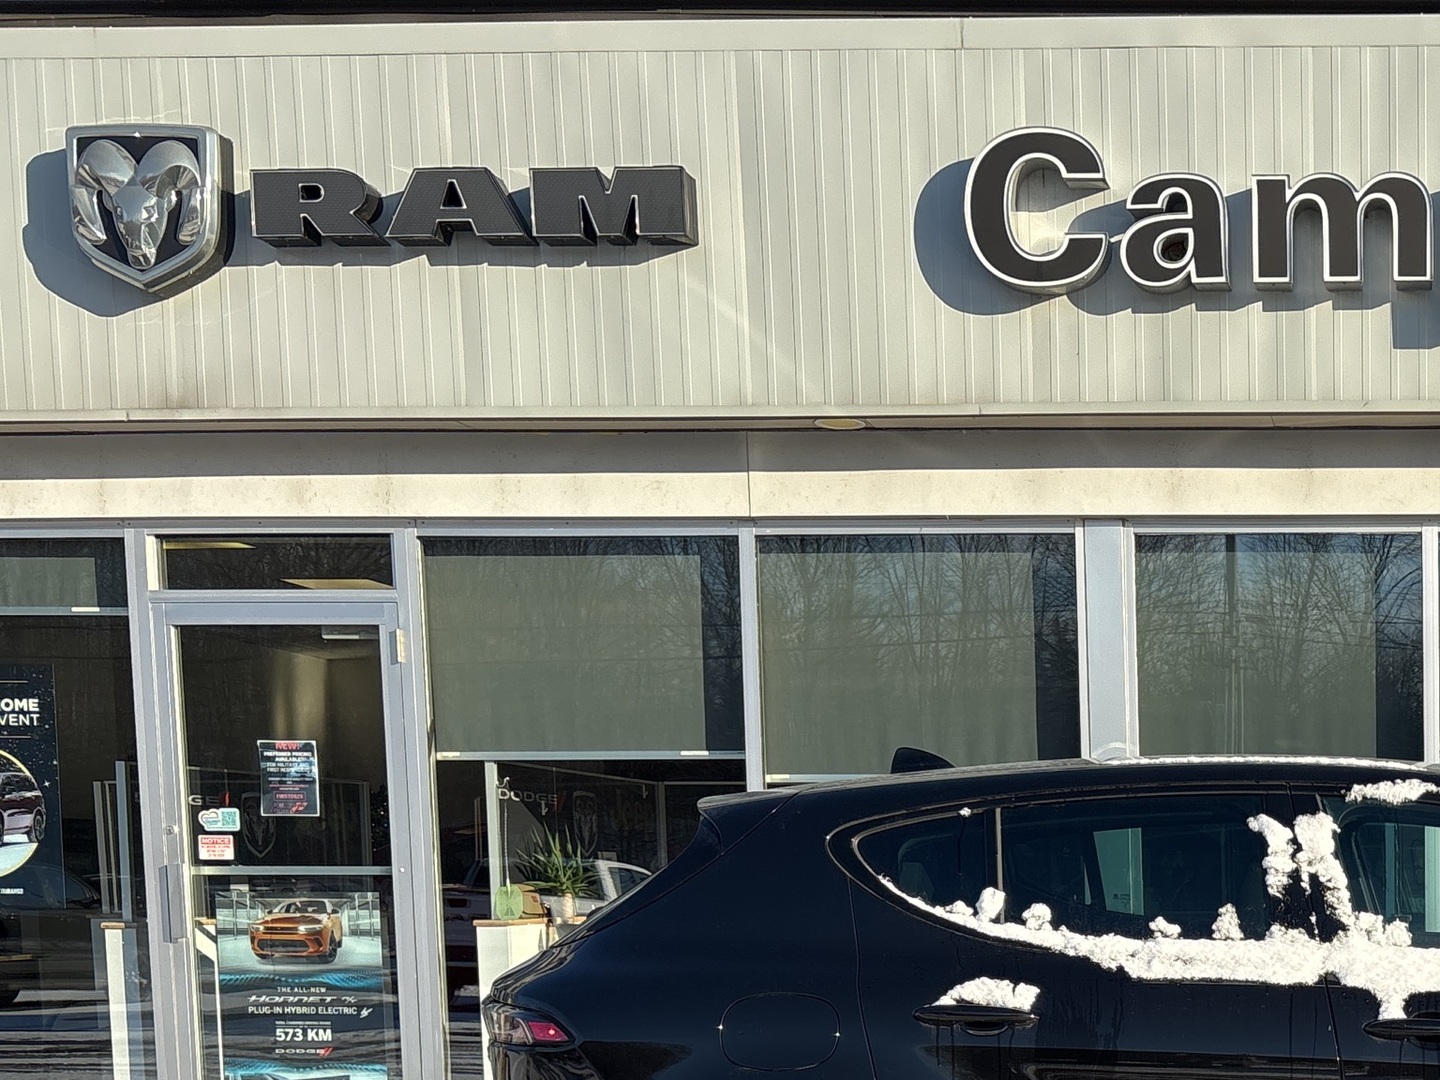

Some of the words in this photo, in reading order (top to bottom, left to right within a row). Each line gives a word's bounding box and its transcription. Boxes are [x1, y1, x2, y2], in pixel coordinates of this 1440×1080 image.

[250, 166, 697, 246] RAM
[0, 697, 40, 712] OME
[0, 713, 40, 726] VENT
[498, 788, 558, 805] DODGE
[247, 994, 337, 1004] HORNET
[248, 1006, 283, 1014] PLUG-IN
[284, 1006, 316, 1014] HYBRID
[318, 1006, 358, 1014] ELECTRIC
[275, 1028, 303, 1042] 573
[307, 1028, 333, 1042] KM
